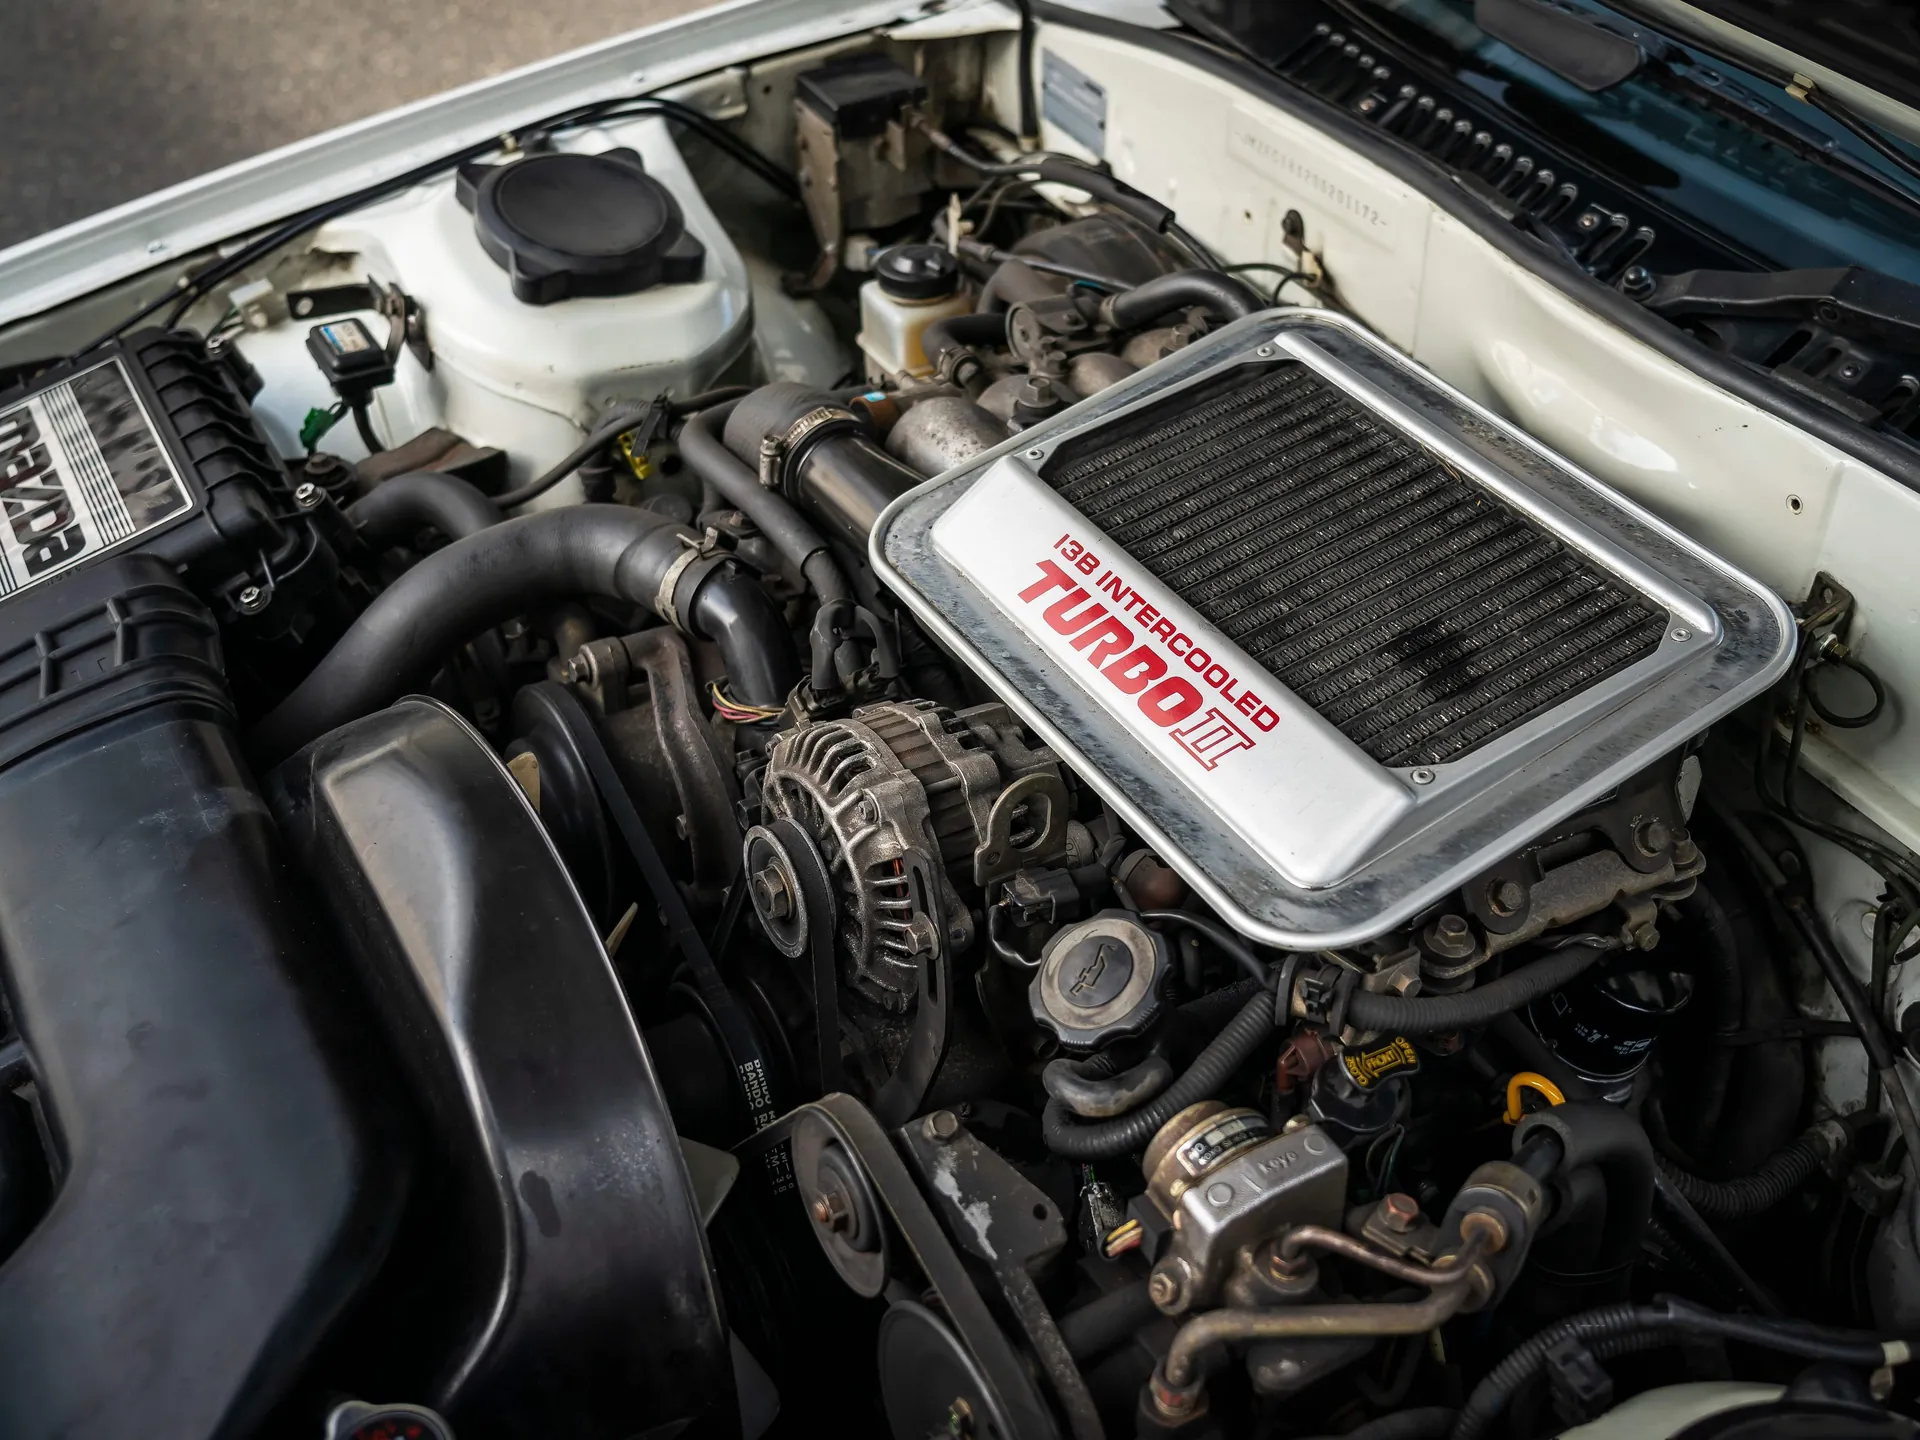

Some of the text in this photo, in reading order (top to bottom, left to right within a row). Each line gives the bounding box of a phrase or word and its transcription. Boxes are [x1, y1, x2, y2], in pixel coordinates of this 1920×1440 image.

[1053, 533, 1281, 733] 13B INTERCOOLED
[1018, 559, 1256, 771] TURBO II
[1365, 1049, 1396, 1070] FRONT
[1395, 1036, 1417, 1064] OPEN
[744, 1061, 764, 1109] BANDO
[1344, 1055, 1369, 1087] CLOSE
